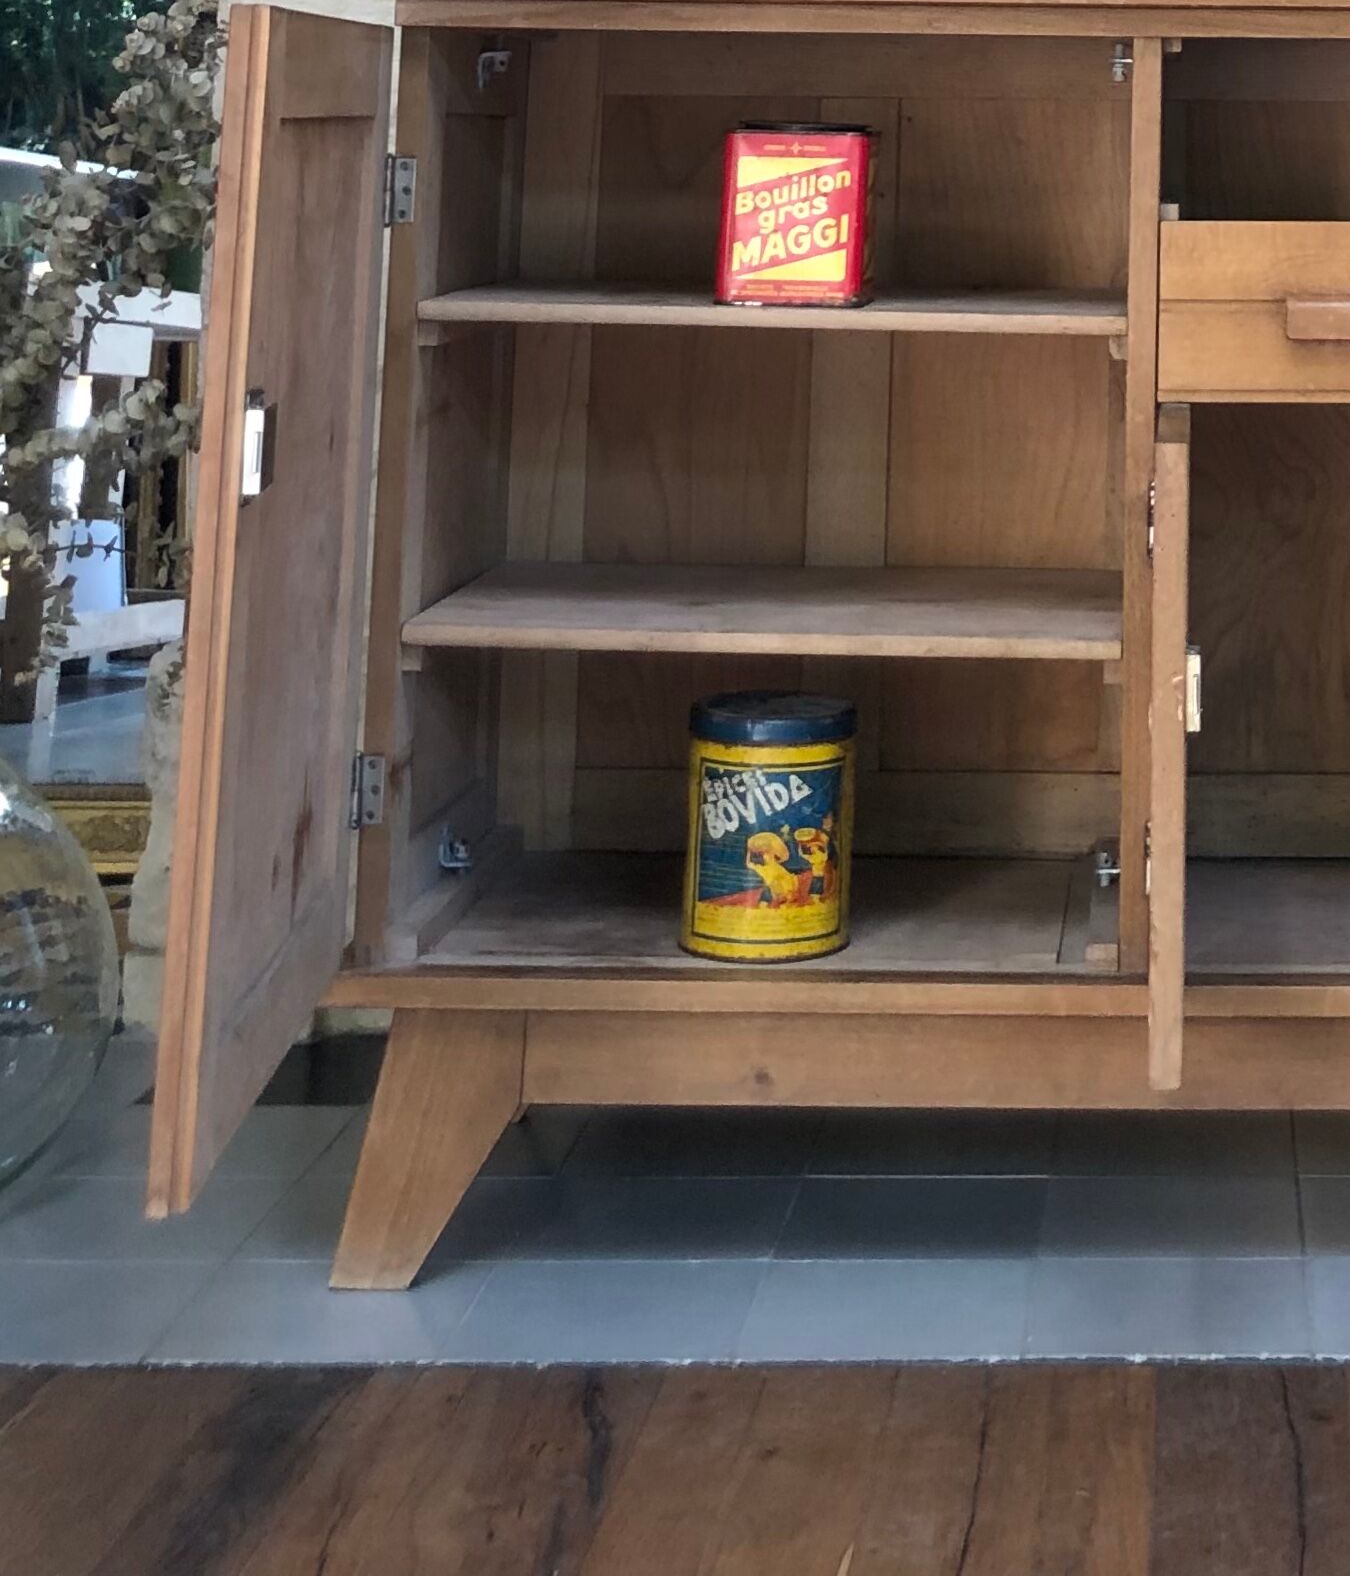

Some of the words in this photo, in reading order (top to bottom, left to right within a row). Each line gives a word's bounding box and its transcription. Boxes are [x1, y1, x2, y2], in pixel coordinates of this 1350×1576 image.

[735, 170, 851, 216] Bouillon
[758, 195, 829, 235] gras
[732, 213, 849, 272] MAGGI
